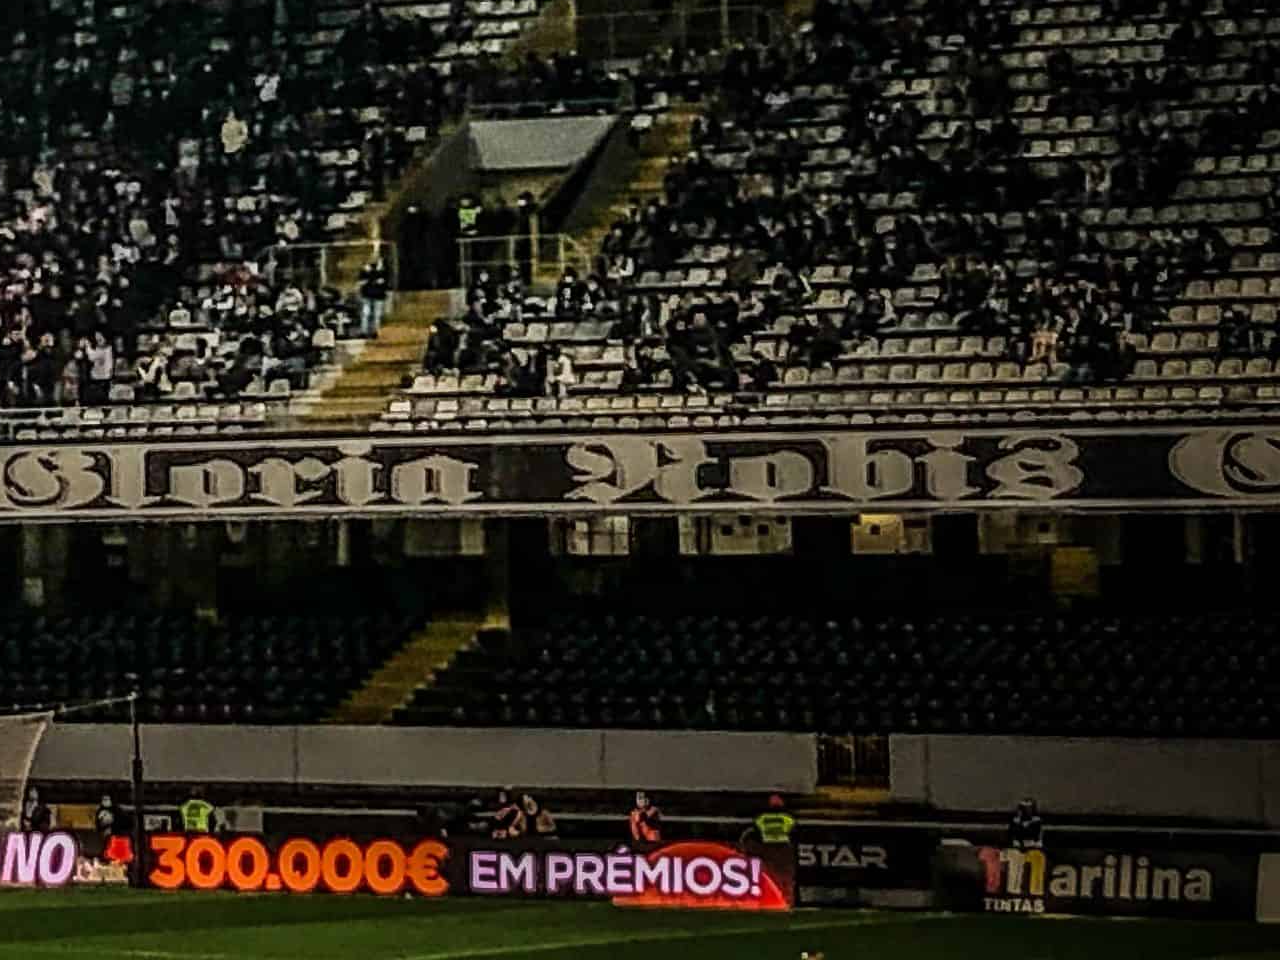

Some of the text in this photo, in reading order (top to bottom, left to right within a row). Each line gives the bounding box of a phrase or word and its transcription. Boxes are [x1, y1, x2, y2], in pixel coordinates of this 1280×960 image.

[563, 433, 1086, 504] Nobis
[148, 836, 449, 897] 300.000€
[471, 851, 535, 891] EM
[546, 846, 762, 897] PRÉMIOS!
[983, 897, 1046, 913] TINTAS
